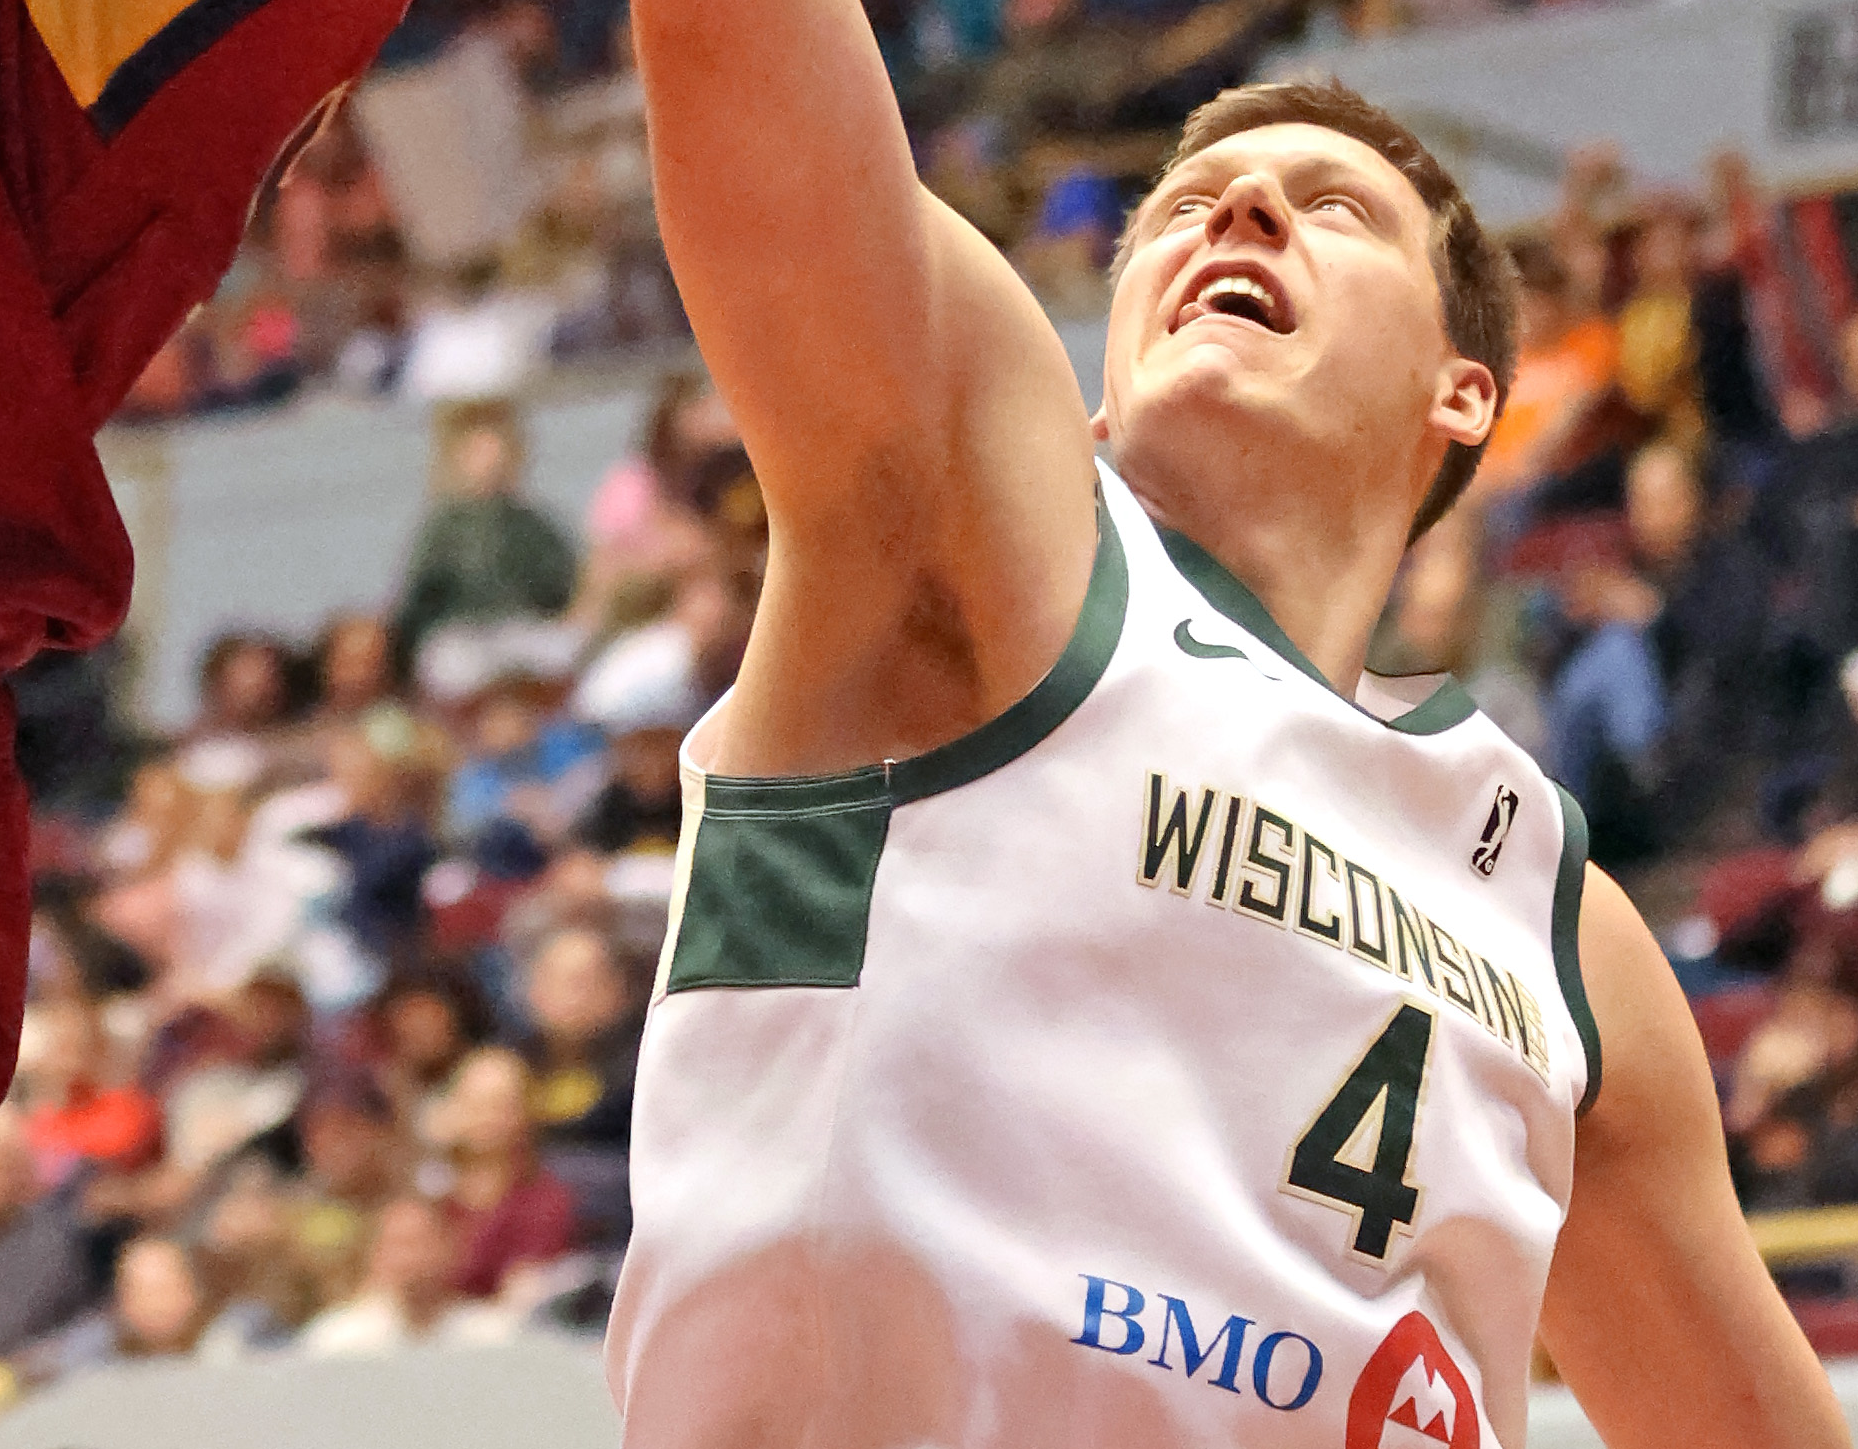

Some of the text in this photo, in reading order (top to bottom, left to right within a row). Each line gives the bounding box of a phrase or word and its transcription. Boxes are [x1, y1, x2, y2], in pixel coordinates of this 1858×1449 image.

[1136, 767, 1550, 1089] WISCONSIN
[1278, 992, 1439, 1274] 4
[1070, 1273, 1324, 1412] BMO
